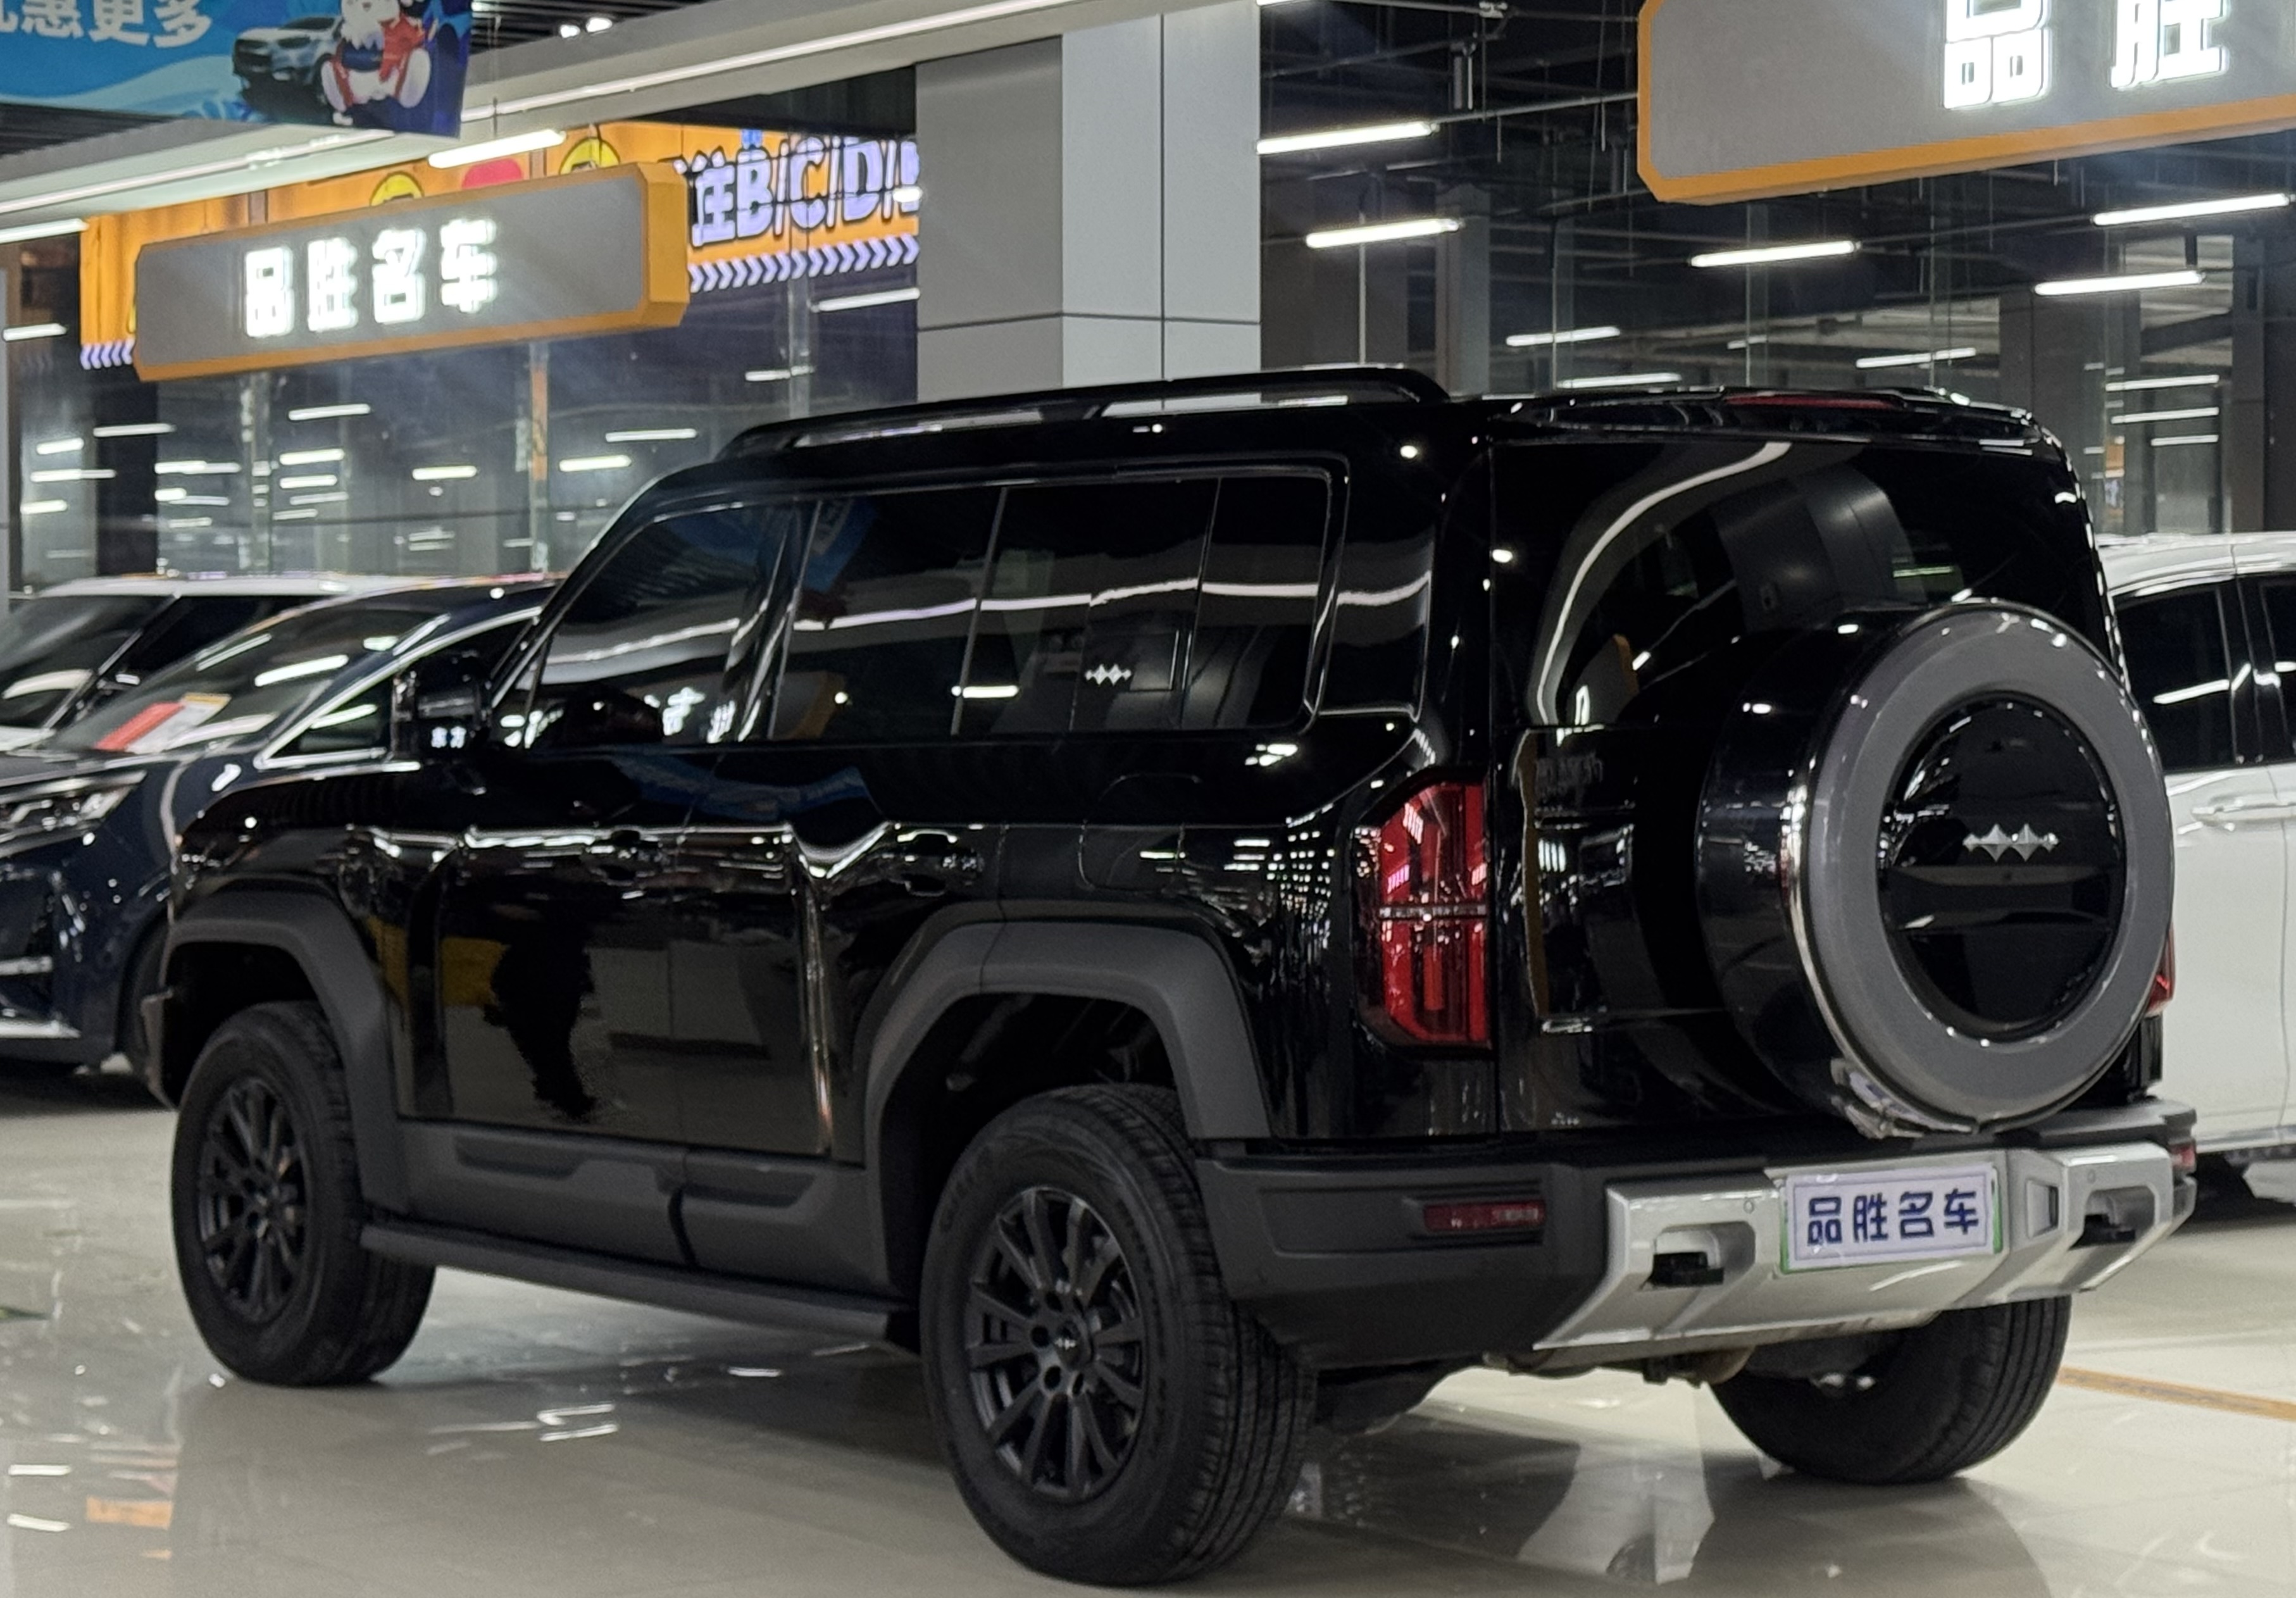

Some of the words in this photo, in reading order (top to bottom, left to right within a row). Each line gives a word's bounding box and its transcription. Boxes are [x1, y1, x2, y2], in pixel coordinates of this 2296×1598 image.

[246, 219, 499, 338] 品胜名车
[1808, 1188, 1979, 1245] 品胜名车
